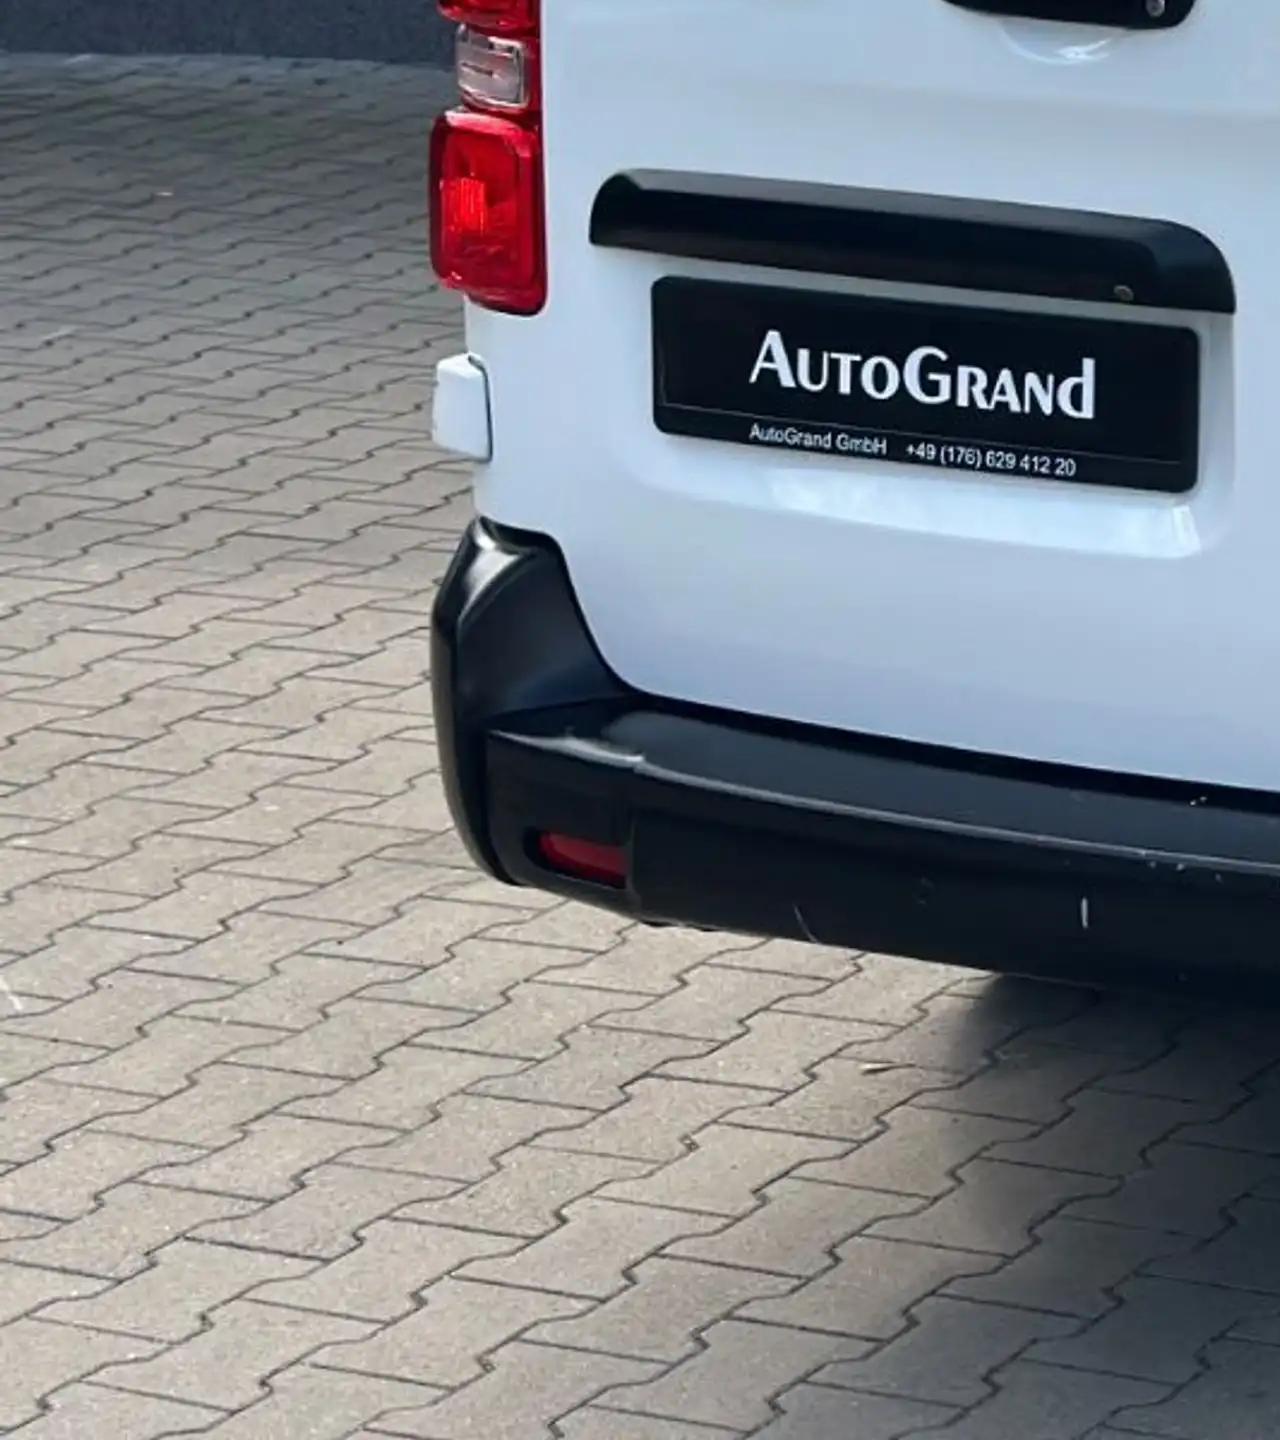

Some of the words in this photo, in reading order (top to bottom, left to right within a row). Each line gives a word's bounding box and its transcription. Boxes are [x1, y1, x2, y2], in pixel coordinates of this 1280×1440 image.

[750, 424, 831, 449] AutoGrand
[836, 434, 887, 456] GmbH
[906, 443, 936, 461] +49
[940, 446, 981, 468] (176)
[985, 451, 1016, 470] 629
[1020, 455, 1052, 475] 412
[1055, 458, 1077, 477] 20
